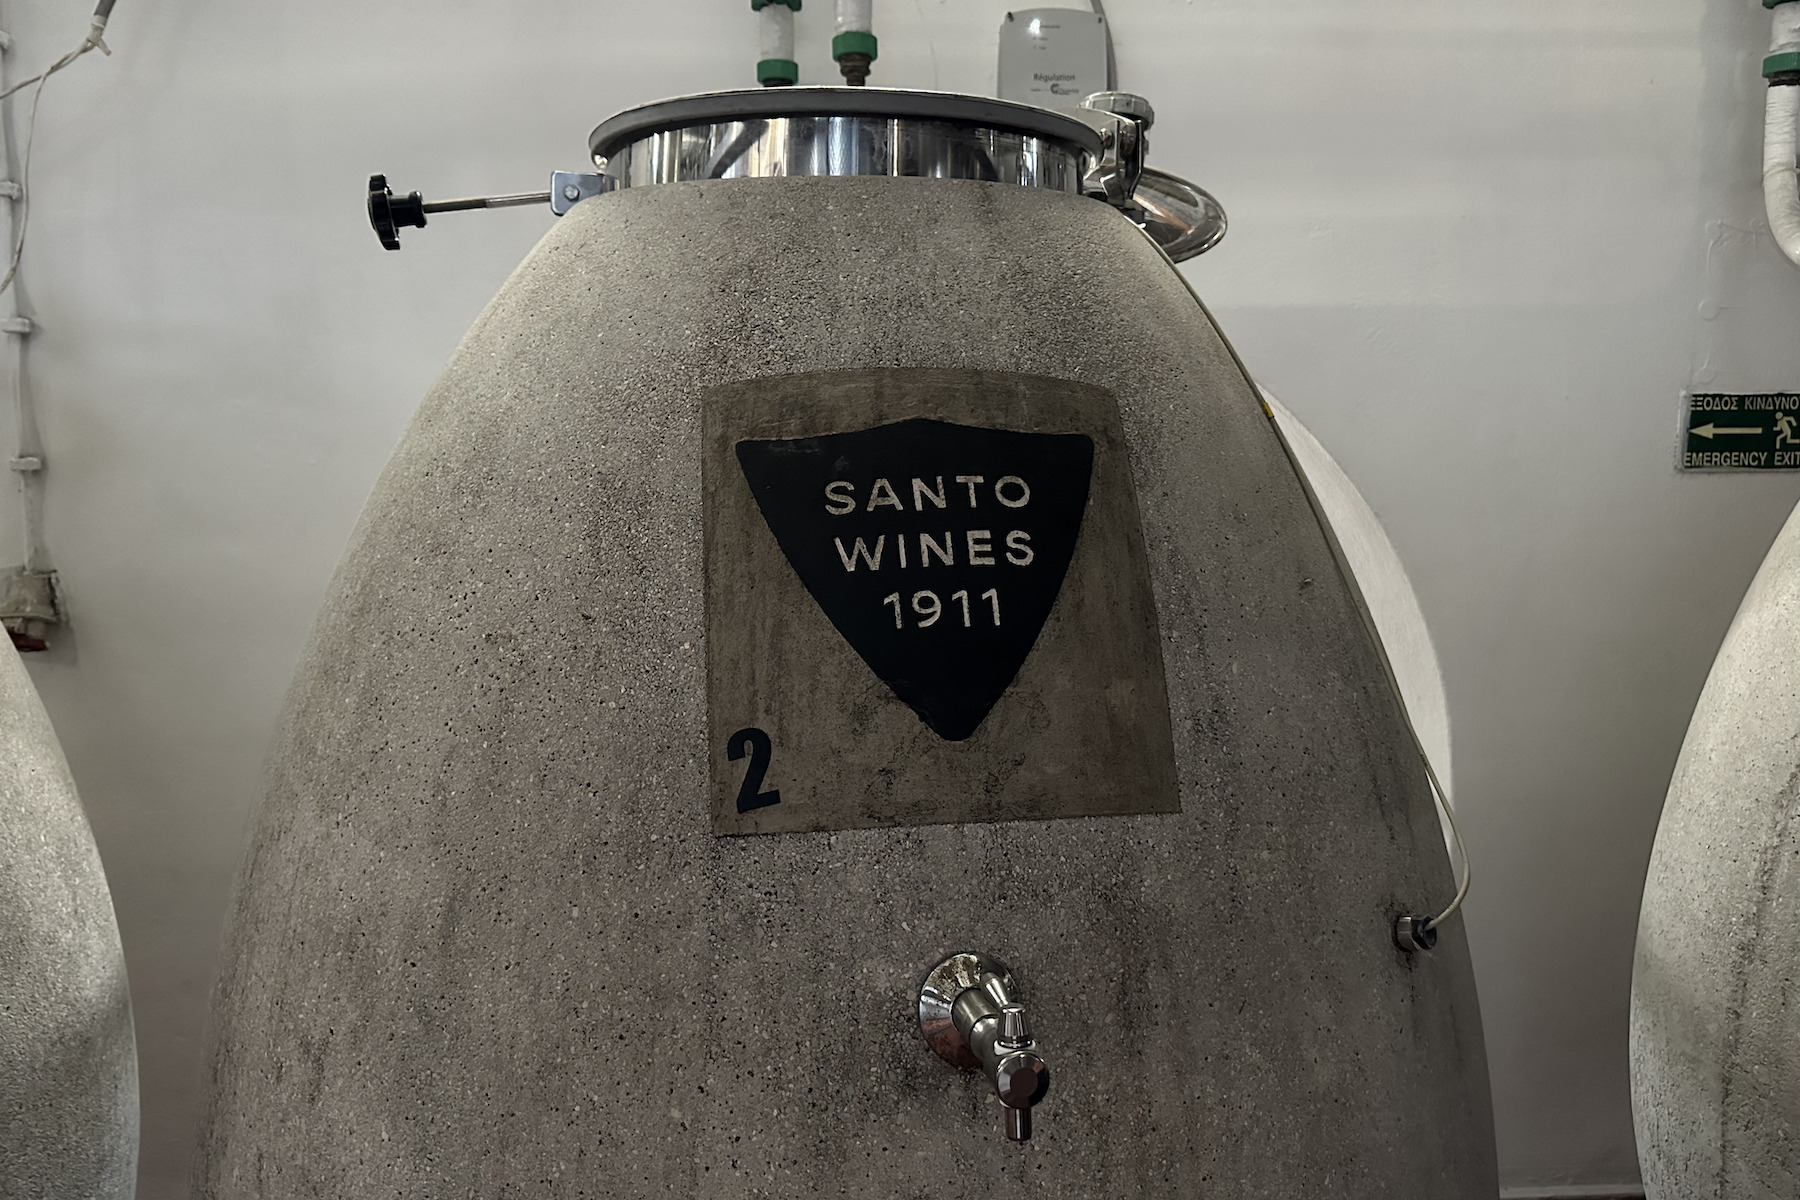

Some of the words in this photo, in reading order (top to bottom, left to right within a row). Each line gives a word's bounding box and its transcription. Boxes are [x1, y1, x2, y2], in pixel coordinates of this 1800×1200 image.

[1744, 396, 1800, 410] ΚΙΝΔΥΝΟ
[1684, 451, 1768, 466] EMERGENCY
[1774, 451, 1800, 466] EXIT
[825, 475, 1030, 515] SANTO
[834, 530, 1034, 572] WINES
[884, 588, 1000, 629] 1911
[727, 727, 781, 814] 2
